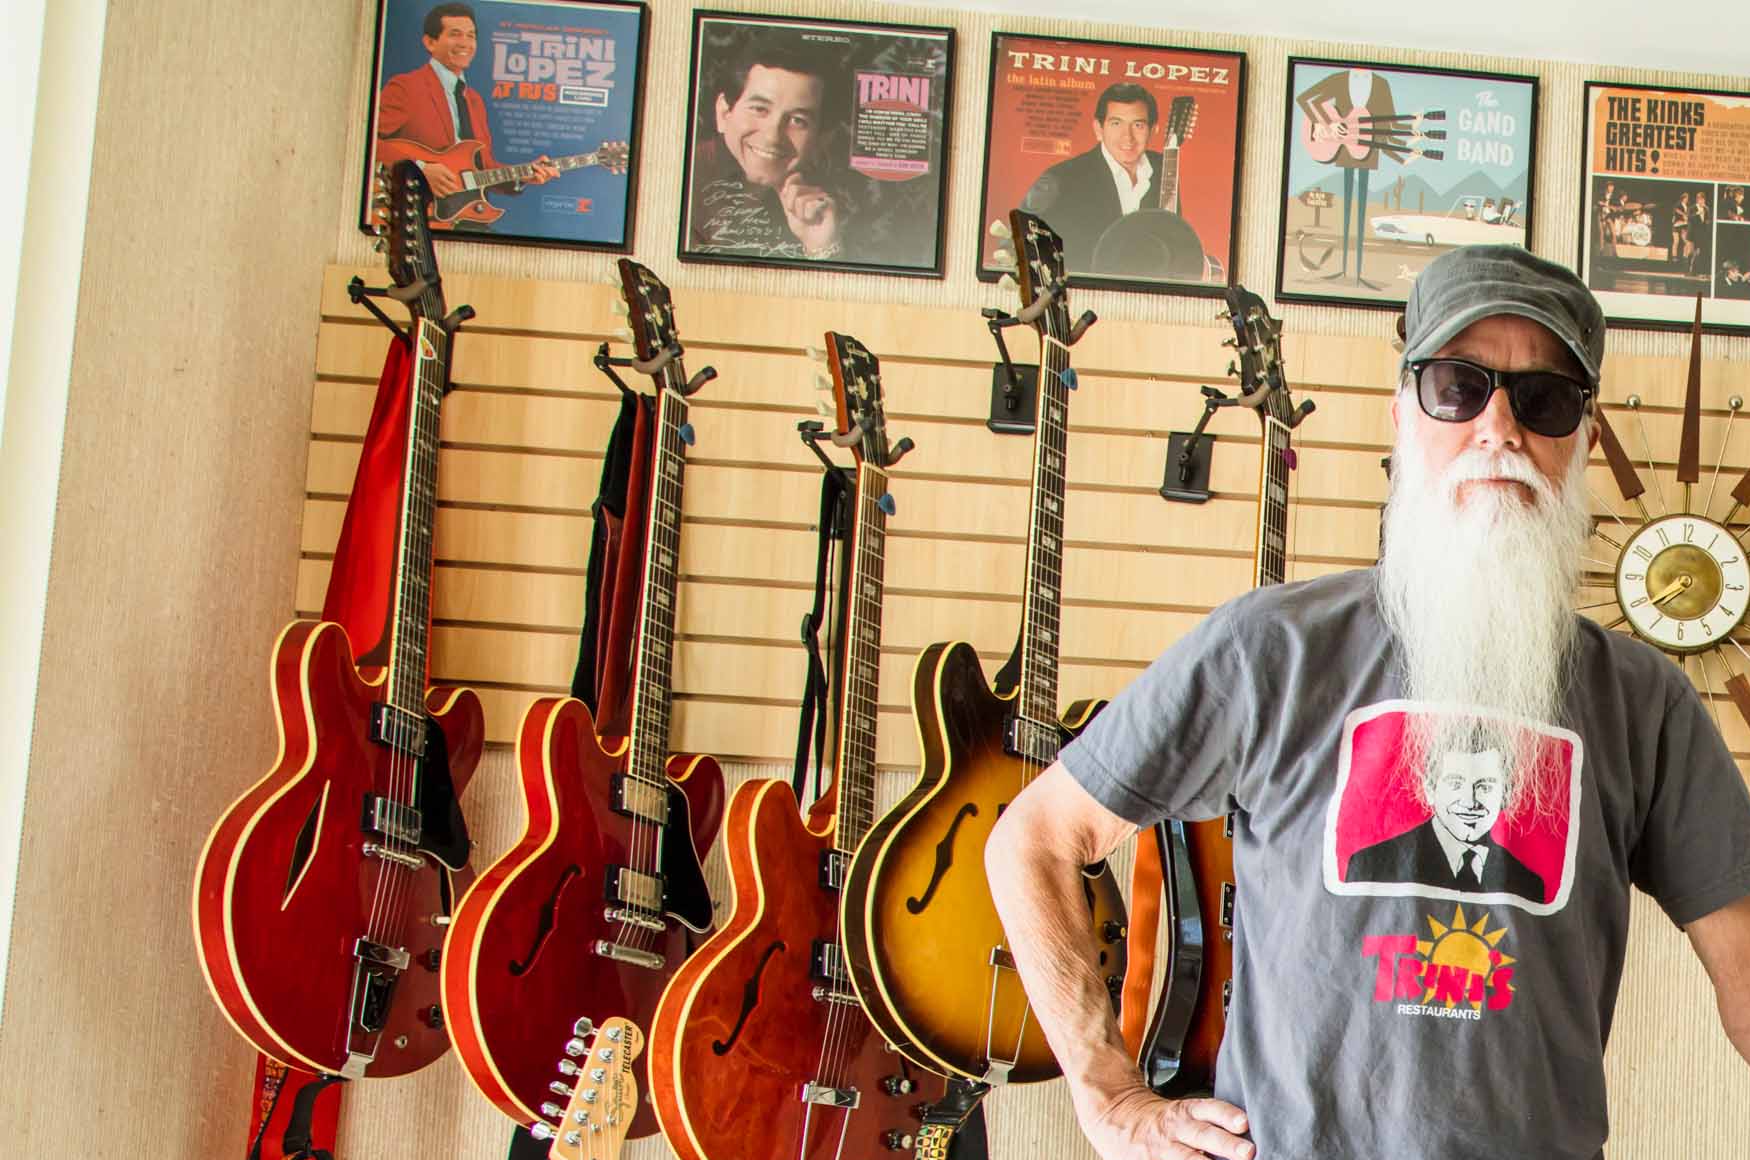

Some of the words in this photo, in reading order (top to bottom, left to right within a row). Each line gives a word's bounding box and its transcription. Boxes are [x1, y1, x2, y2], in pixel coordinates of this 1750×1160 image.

[520, 31, 616, 60] TRINI
[492, 42, 616, 88] LOPEZ
[1008, 50, 1110, 75] TRINI
[1125, 60, 1230, 85] LOPEZ
[1007, 73, 1025, 85] the
[1029, 75, 1056, 88] latin
[1059, 79, 1097, 91] album
[857, 72, 930, 112] TRINI
[1607, 96, 1641, 122] THE
[1646, 99, 1705, 127] KINKS
[1458, 108, 1516, 137] GAND
[1605, 121, 1698, 152] GREATEST
[1456, 138, 1515, 167] BAND
[1655, 527, 1670, 546] 11
[1683, 523, 1694, 543] 12
[1707, 533, 1719, 550] 1
[1632, 544, 1653, 562] 10
[1720, 555, 1739, 568] 2
[1625, 573, 1644, 581] 9
[1725, 583, 1745, 591] 3
[1630, 596, 1649, 608] 8
[1718, 604, 1735, 618] 4
[1648, 614, 1664, 630] 7
[1677, 622, 1684, 641] 6
[1700, 618, 1712, 636] 5
[1397, 1003, 1481, 1020] RESTAURANTS
[622, 1024, 633, 1074] TELECASTER
